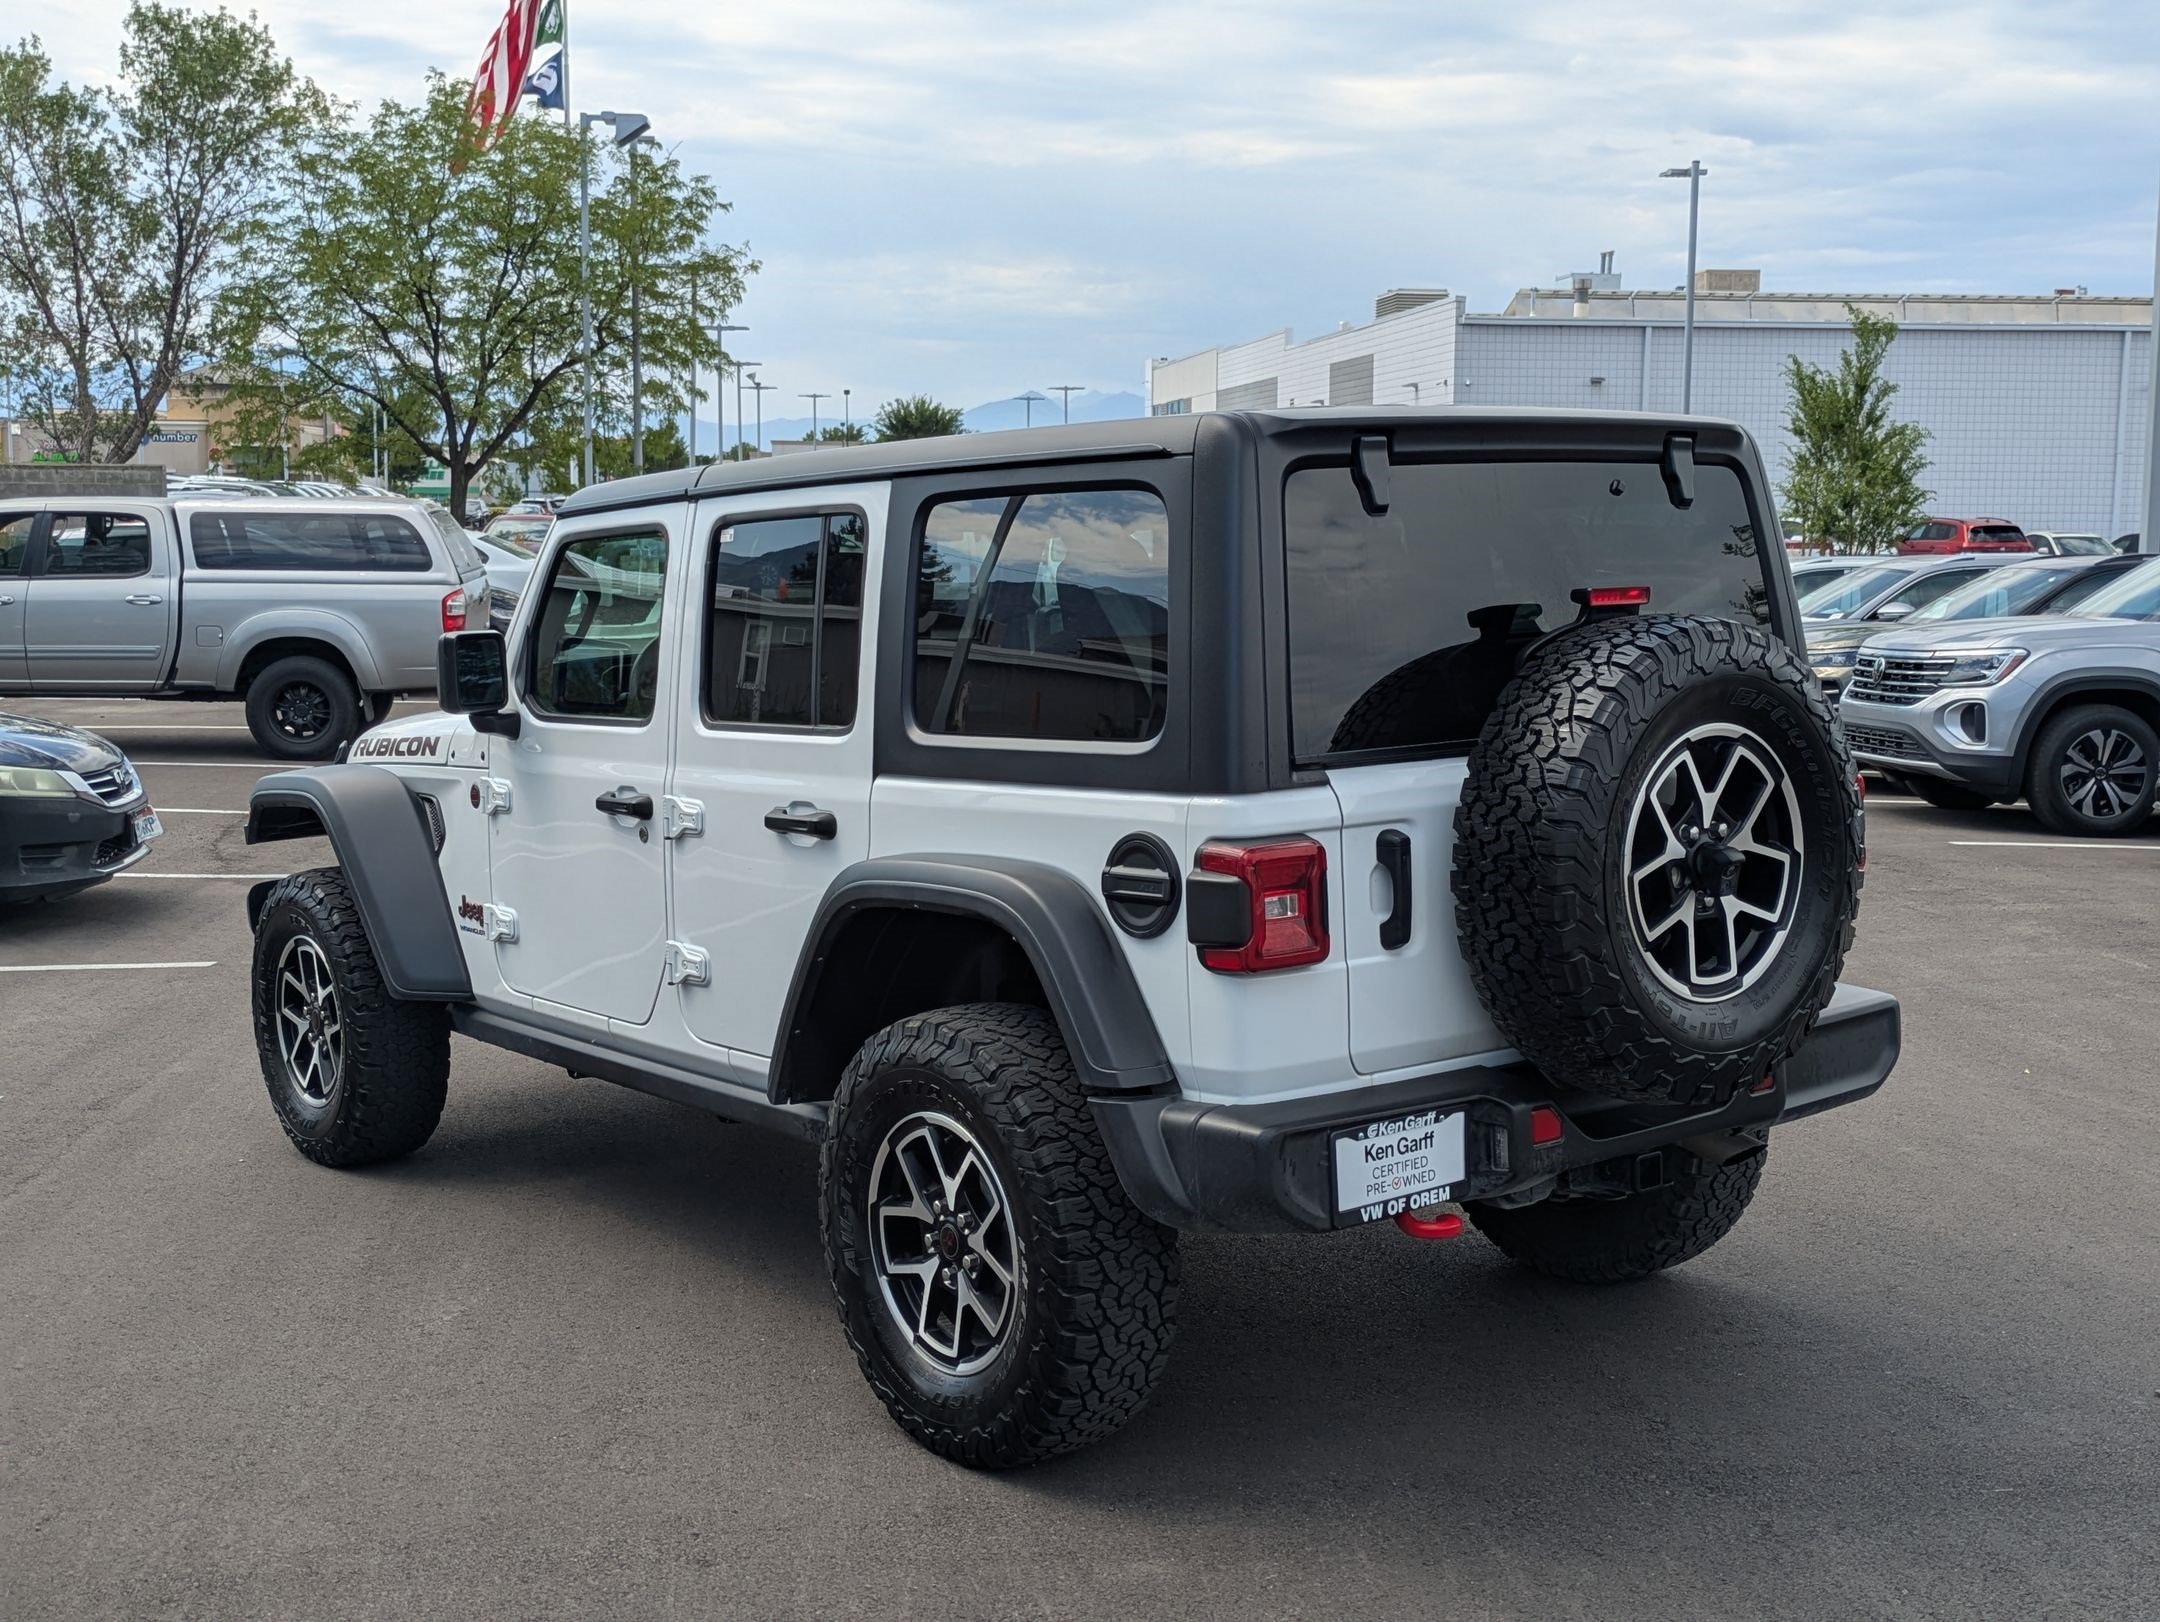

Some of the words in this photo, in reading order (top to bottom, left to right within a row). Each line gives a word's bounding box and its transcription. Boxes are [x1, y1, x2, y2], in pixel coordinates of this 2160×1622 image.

[152, 431, 197, 442] number
[353, 736, 440, 757] RUBICON
[458, 895, 484, 928] Jeep
[460, 924, 486, 936] WRANGLER
[1378, 1119, 1404, 1137] Ken
[1404, 1111, 1437, 1130] Garff
[1364, 1141, 1396, 1163] Ken
[1396, 1131, 1435, 1154] Garff
[1372, 1155, 1429, 1180] CERTIFIED
[1360, 1203, 1384, 1223] VW
[1387, 1197, 1406, 1217] OF
[1409, 1186, 1450, 1210] OREM
